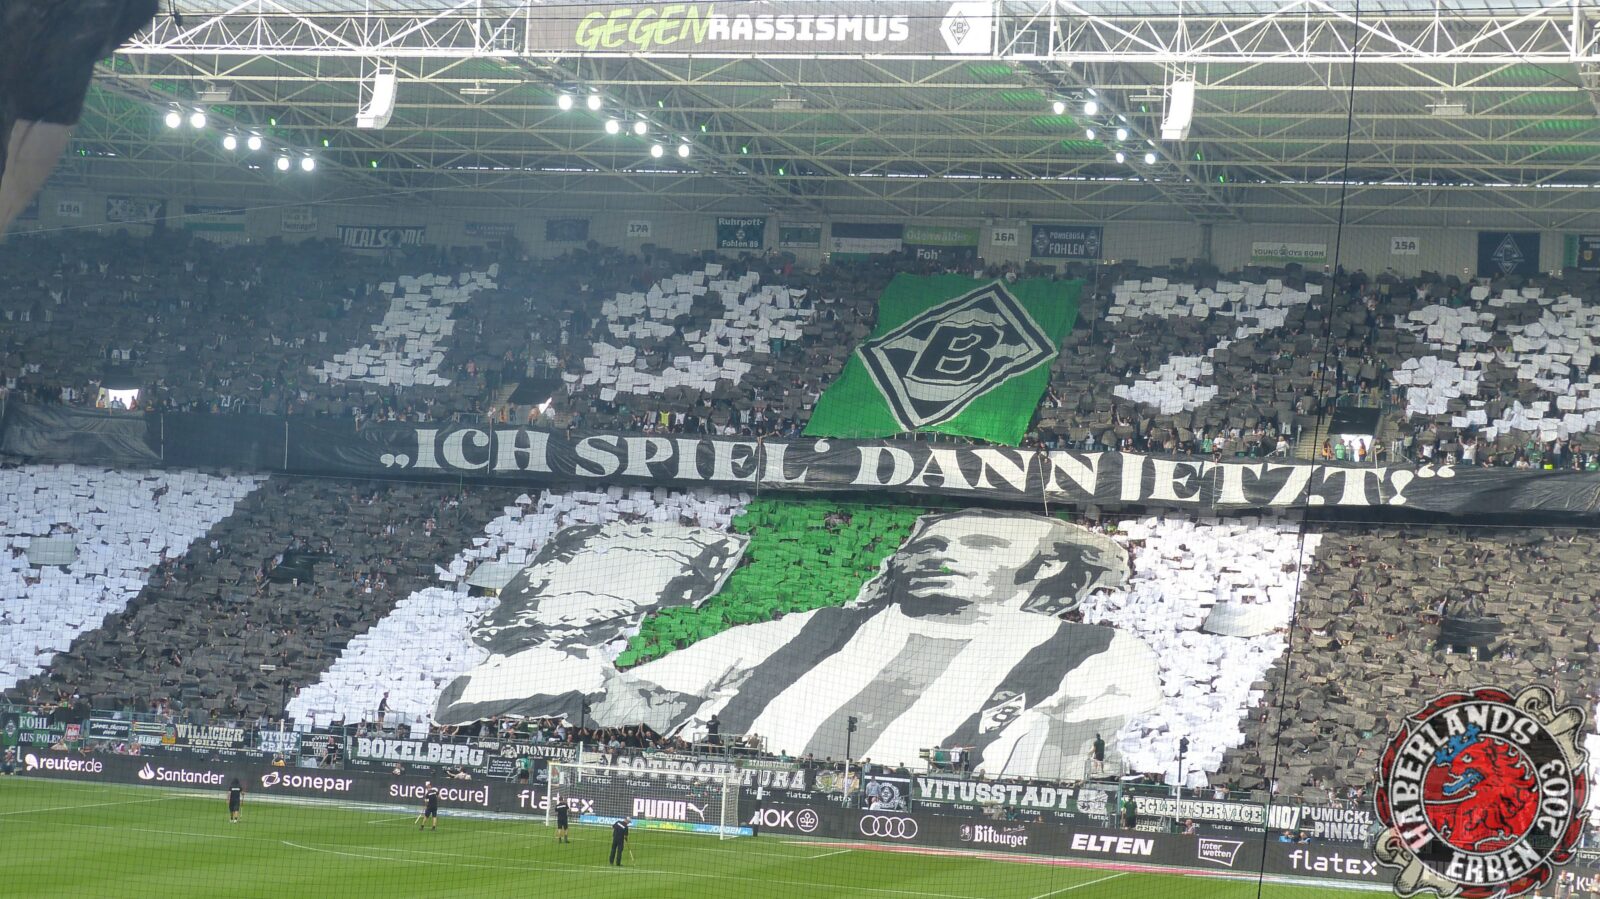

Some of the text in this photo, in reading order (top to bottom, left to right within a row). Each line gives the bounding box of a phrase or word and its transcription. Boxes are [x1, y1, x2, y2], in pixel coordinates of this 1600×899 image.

[575, 4, 910, 51] GEGEN RASSISMUS
[629, 223, 649, 234] 17A
[994, 232, 1016, 242] 16A
[1048, 242, 1085, 255] FOHLEN
[1394, 241, 1417, 251] 15A
[851, 446, 1102, 496] DANN
[18, 733, 35, 742] AUS
[357, 738, 484, 766] BÖKELBERG
[516, 744, 576, 759] FRONTLINE
[40, 756, 103, 773] reuter.de
[156, 767, 225, 785] Santander
[282, 774, 353, 792] sonepar
[917, 777, 1074, 809] VITUSSTADT
[633, 798, 687, 820] PUMA
[1301, 806, 1373, 825] PUMUCKL
[973, 824, 1029, 848] Bitburger
[1314, 821, 1369, 841] PINKIS
[1070, 833, 1155, 856] ELTEN
[1201, 840, 1223, 850] inter
[1202, 850, 1232, 858] wetten
[1288, 849, 1378, 876] flatex
